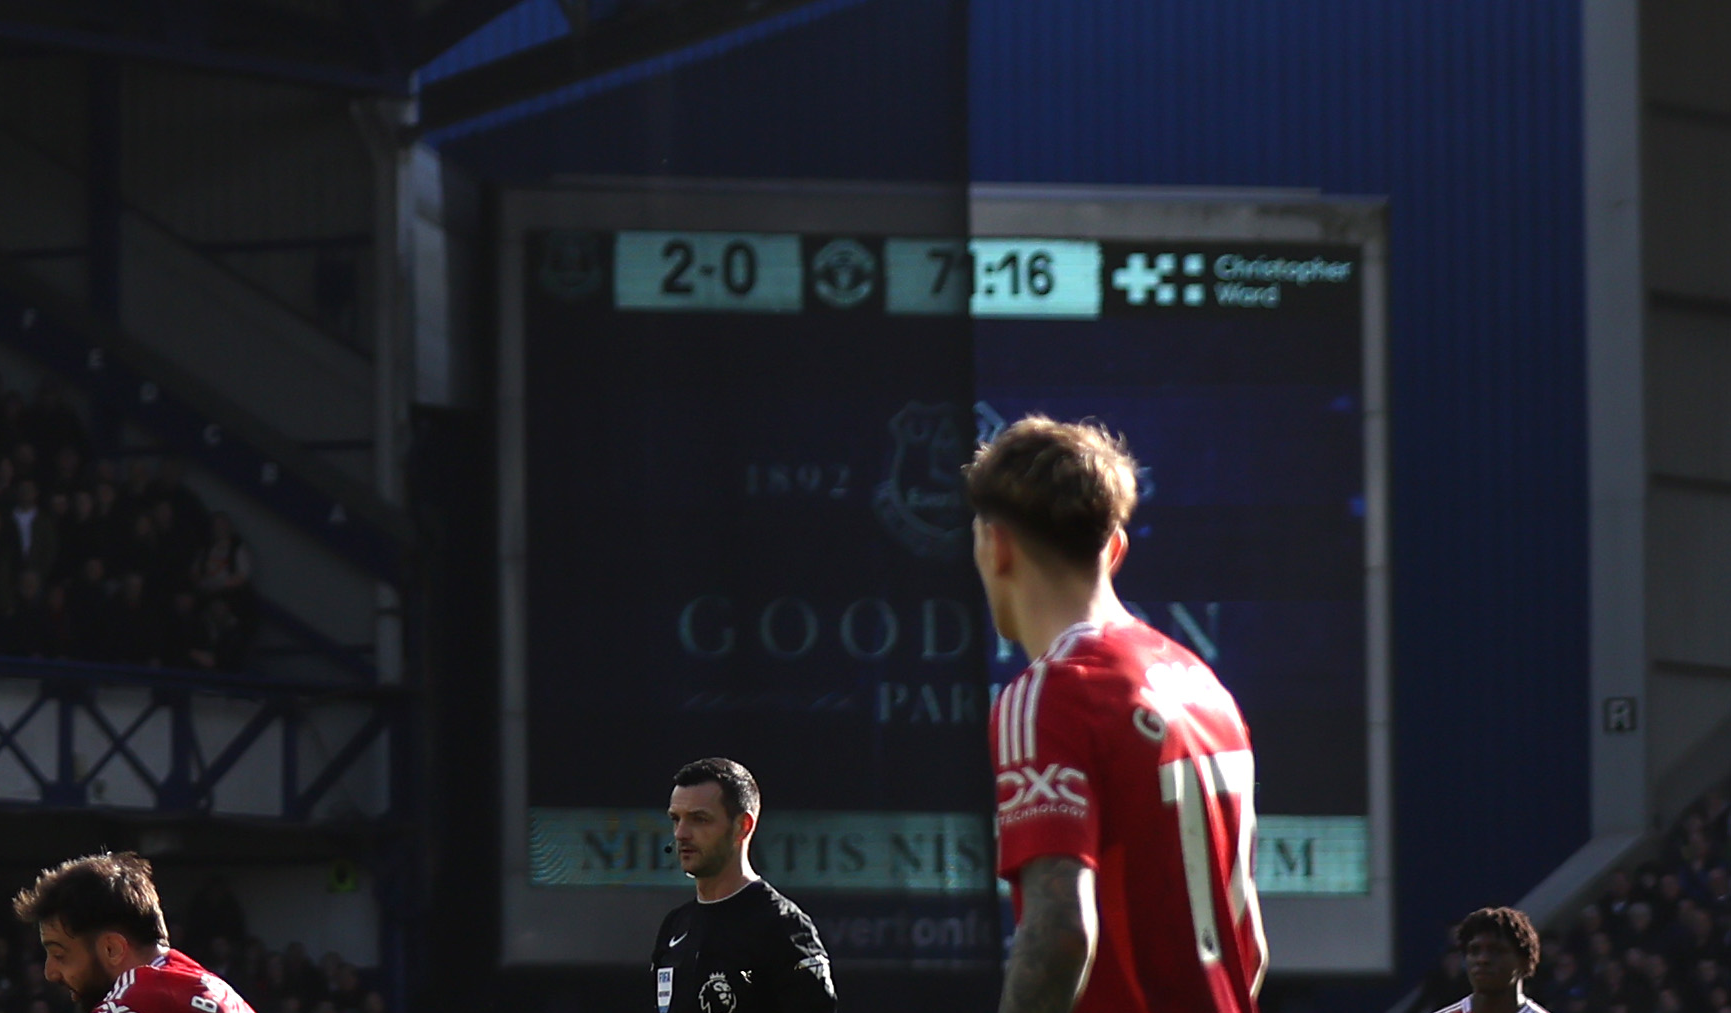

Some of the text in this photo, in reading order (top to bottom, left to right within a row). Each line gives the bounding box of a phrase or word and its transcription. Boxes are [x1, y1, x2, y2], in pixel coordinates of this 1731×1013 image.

[660, 242, 756, 295] 2-0
[1214, 253, 1354, 288] Christopher
[1215, 281, 1281, 310] Ward
